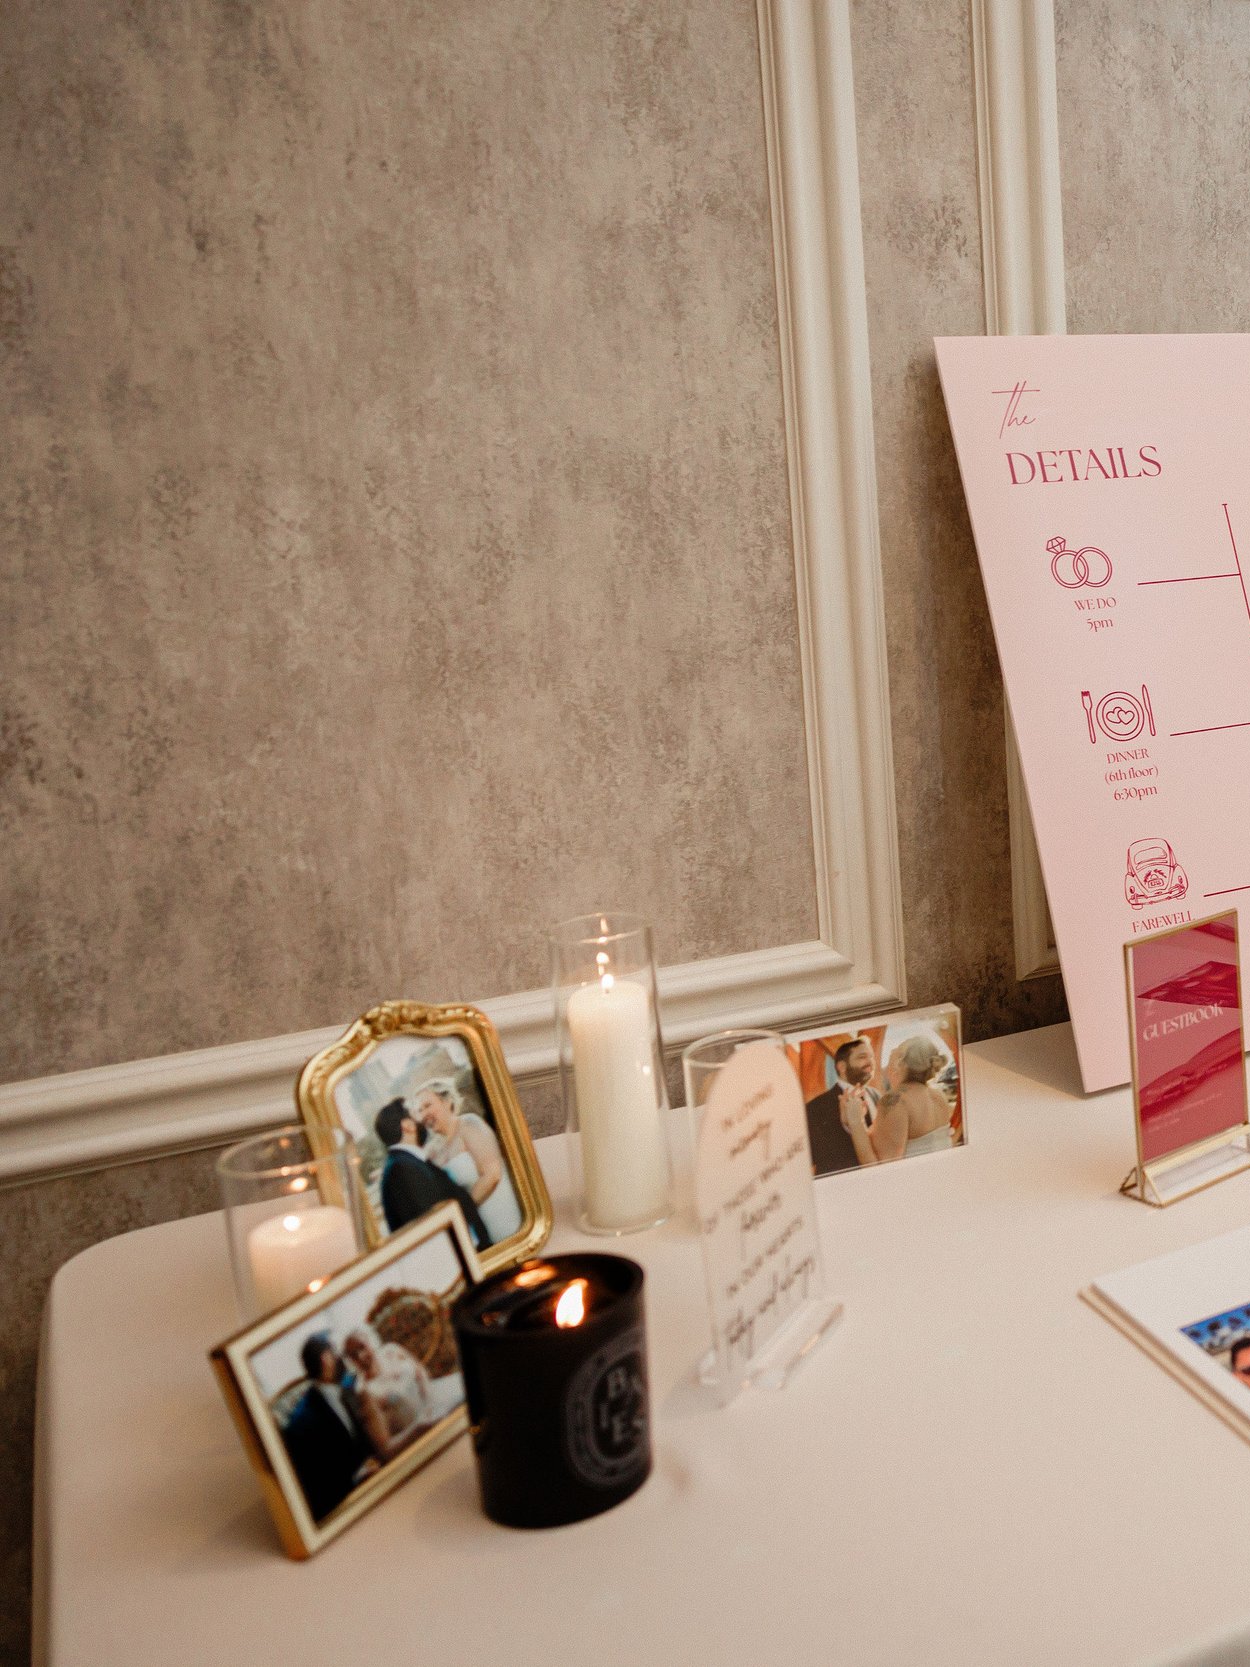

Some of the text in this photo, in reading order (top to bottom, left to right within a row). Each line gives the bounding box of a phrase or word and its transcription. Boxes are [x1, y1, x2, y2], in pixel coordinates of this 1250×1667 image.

[991, 380, 1041, 439] the
[1005, 445, 1162, 486] DETAILS
[1073, 597, 1117, 611] WE DO
[1086, 618, 1114, 633] 5pm
[1106, 747, 1150, 764] DINNER
[1104, 765, 1159, 784] (6th floor)
[1113, 786, 1158, 801] 6:30pm
[1132, 910, 1196, 933] FAREWELL
[1142, 1002, 1225, 1042] GUESTBOOK
